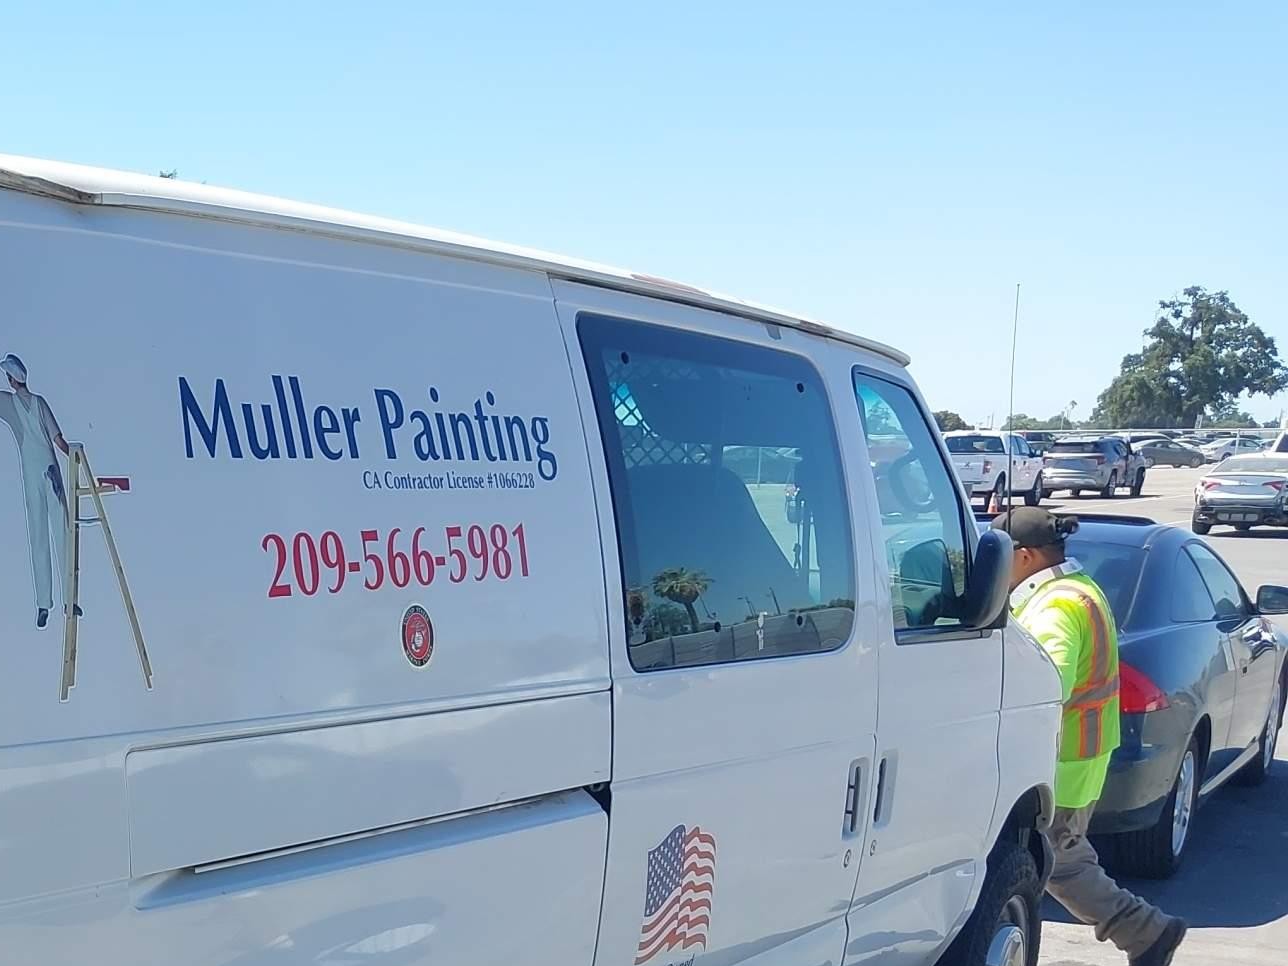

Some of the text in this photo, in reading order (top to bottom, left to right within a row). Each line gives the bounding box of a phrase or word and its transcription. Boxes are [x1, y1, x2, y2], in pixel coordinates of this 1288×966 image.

[178, 375, 558, 481] Muller Painting
[362, 471, 535, 489] CA Contractor License #1066228
[261, 522, 529, 598] 209-566-5981
